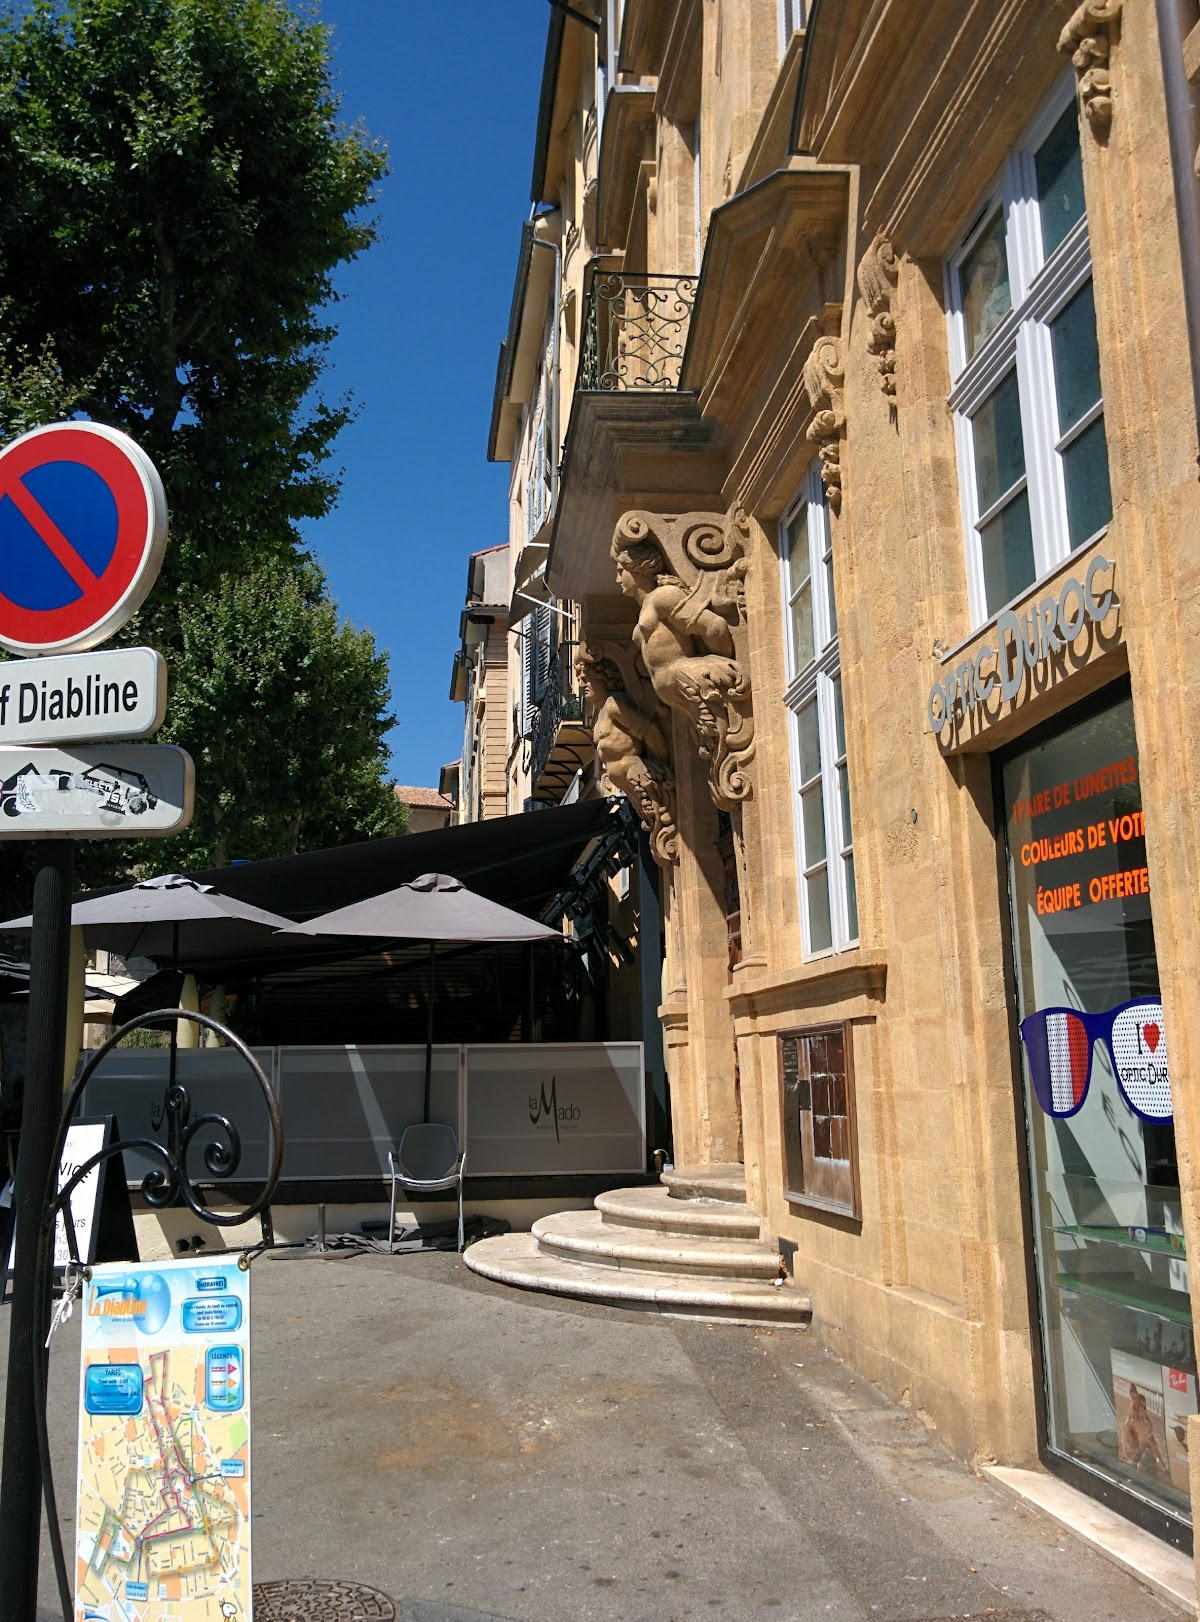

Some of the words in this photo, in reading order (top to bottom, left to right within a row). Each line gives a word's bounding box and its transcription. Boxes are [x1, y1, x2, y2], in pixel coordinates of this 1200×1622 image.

[19, 674, 138, 723] Diabline
[1053, 781, 1071, 809] DE
[1074, 756, 1137, 801] LUNETTES
[1021, 829, 1084, 866] COULEURS
[1087, 822, 1106, 849] DE
[1037, 884, 1081, 915] ÉQUIPE
[528, 1095, 537, 1110] la
[530, 1076, 581, 1144] Mado
